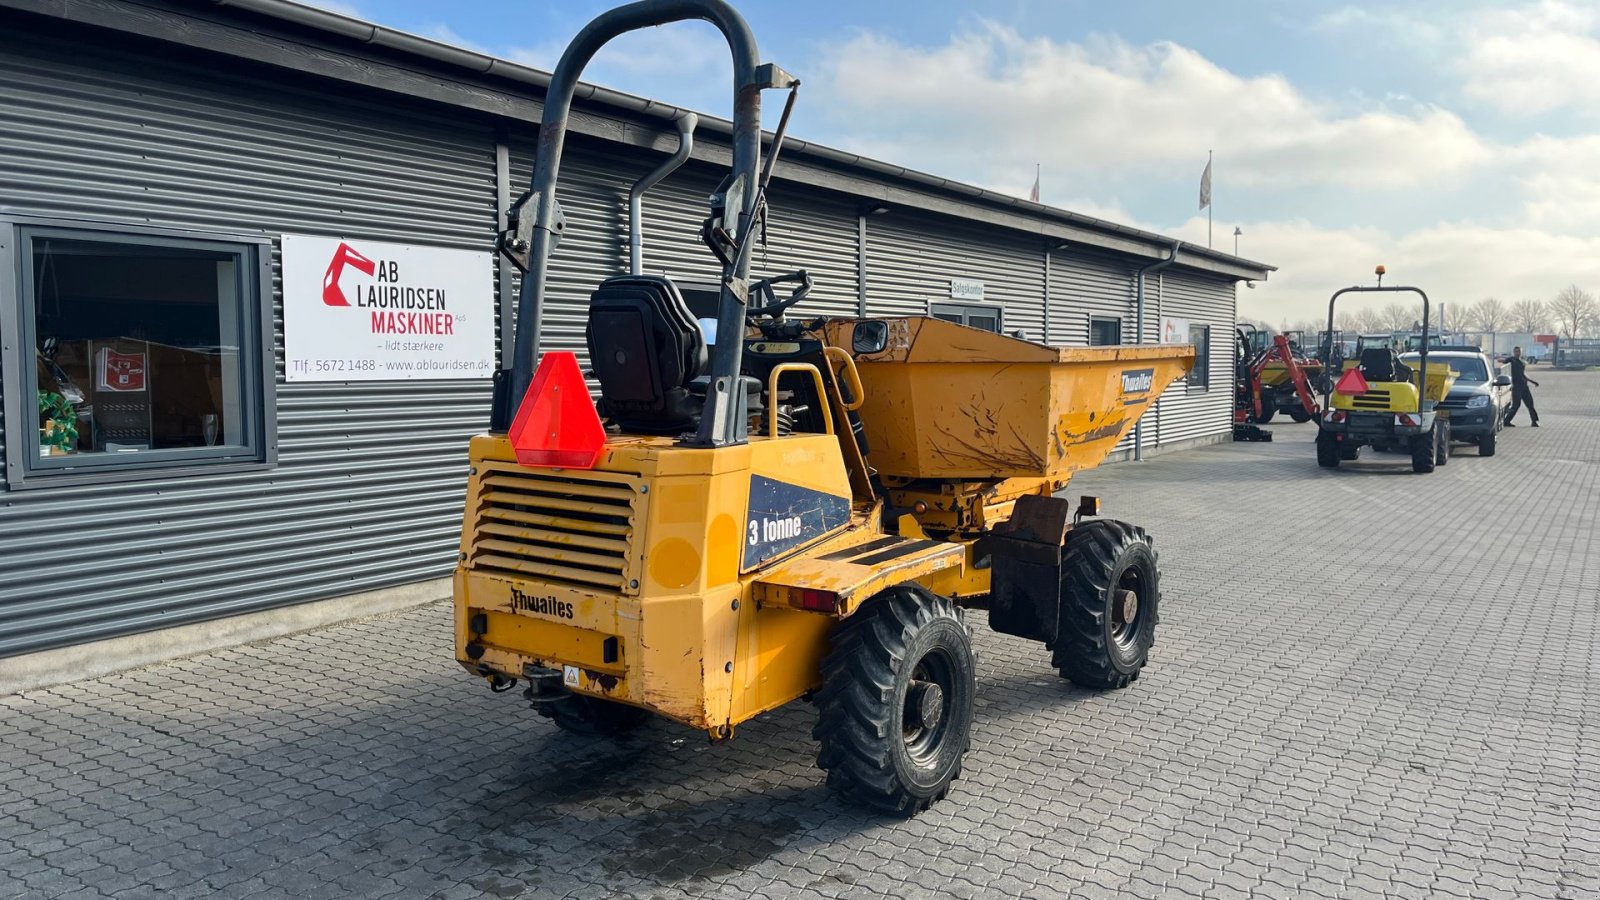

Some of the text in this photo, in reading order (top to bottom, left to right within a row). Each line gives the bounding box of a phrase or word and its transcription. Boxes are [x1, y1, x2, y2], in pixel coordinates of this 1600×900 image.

[378, 260, 399, 283] AB
[357, 284, 446, 311] LAURIDSEN
[952, 282, 984, 296] Salgskontor
[371, 311, 453, 335] MASKINER
[385, 340, 401, 351] lidt
[402, 341, 444, 351] stærkere
[292, 360, 312, 374] Tlf.
[316, 360, 345, 372] 5672
[348, 360, 376, 371] 1488
[385, 360, 490, 371] www.ablauridsen.dk
[1122, 373, 1152, 392] Thwaites
[749, 516, 802, 546] 3 tonne
[511, 587, 574, 619] Thwaites
